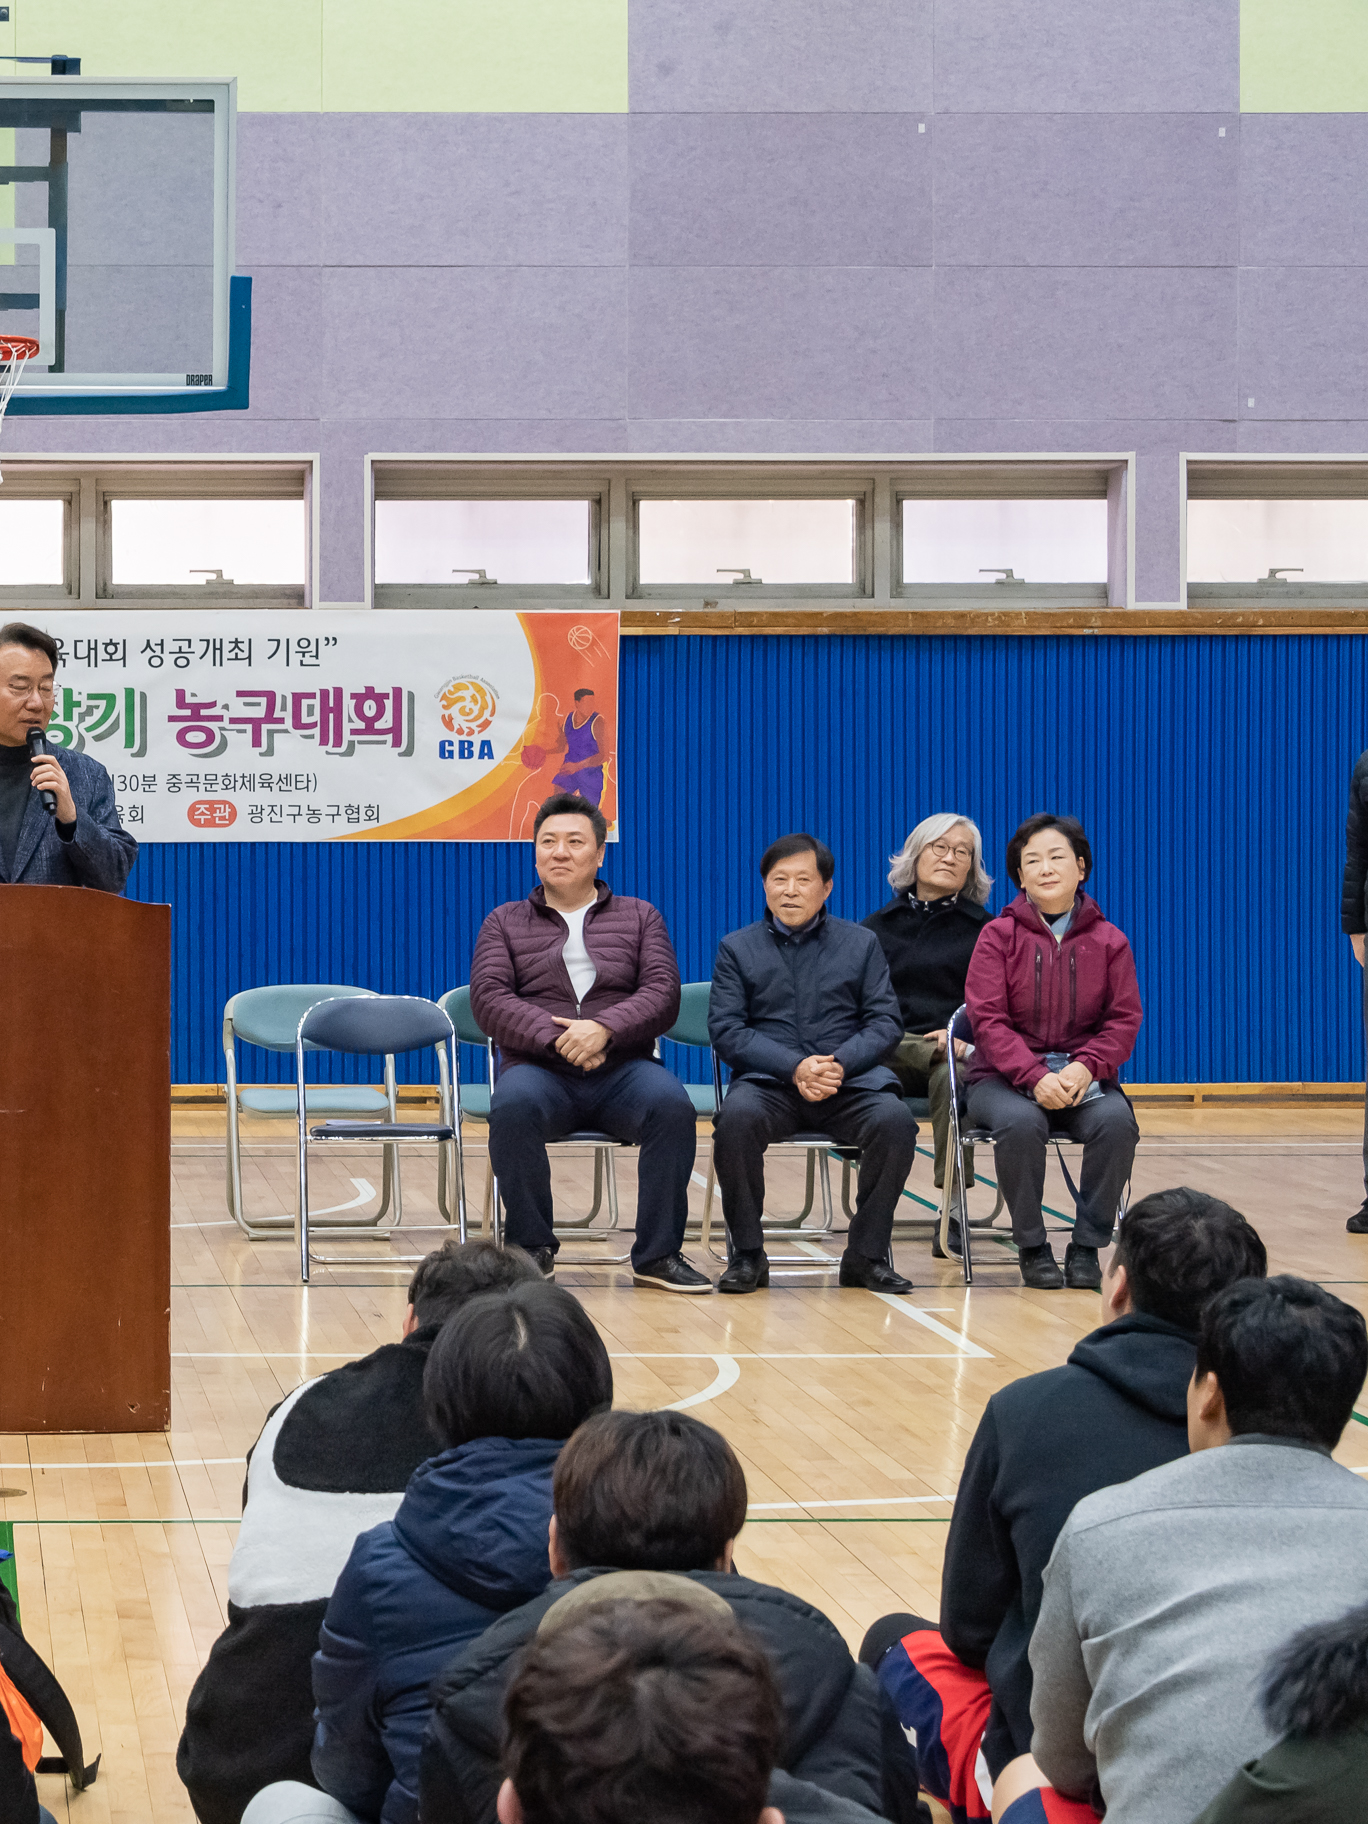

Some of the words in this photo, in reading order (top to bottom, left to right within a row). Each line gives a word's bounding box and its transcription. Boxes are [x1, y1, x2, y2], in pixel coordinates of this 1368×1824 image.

[140, 637, 252, 669] 성공개최
[267, 636, 338, 668] 기원”
[167, 686, 404, 750] 농구대회
[439, 739, 495, 760] GBA
[165, 772, 318, 794] 중곡문화체육센타)
[192, 803, 232, 824] 주관
[247, 803, 380, 824] 광진구농구협회
